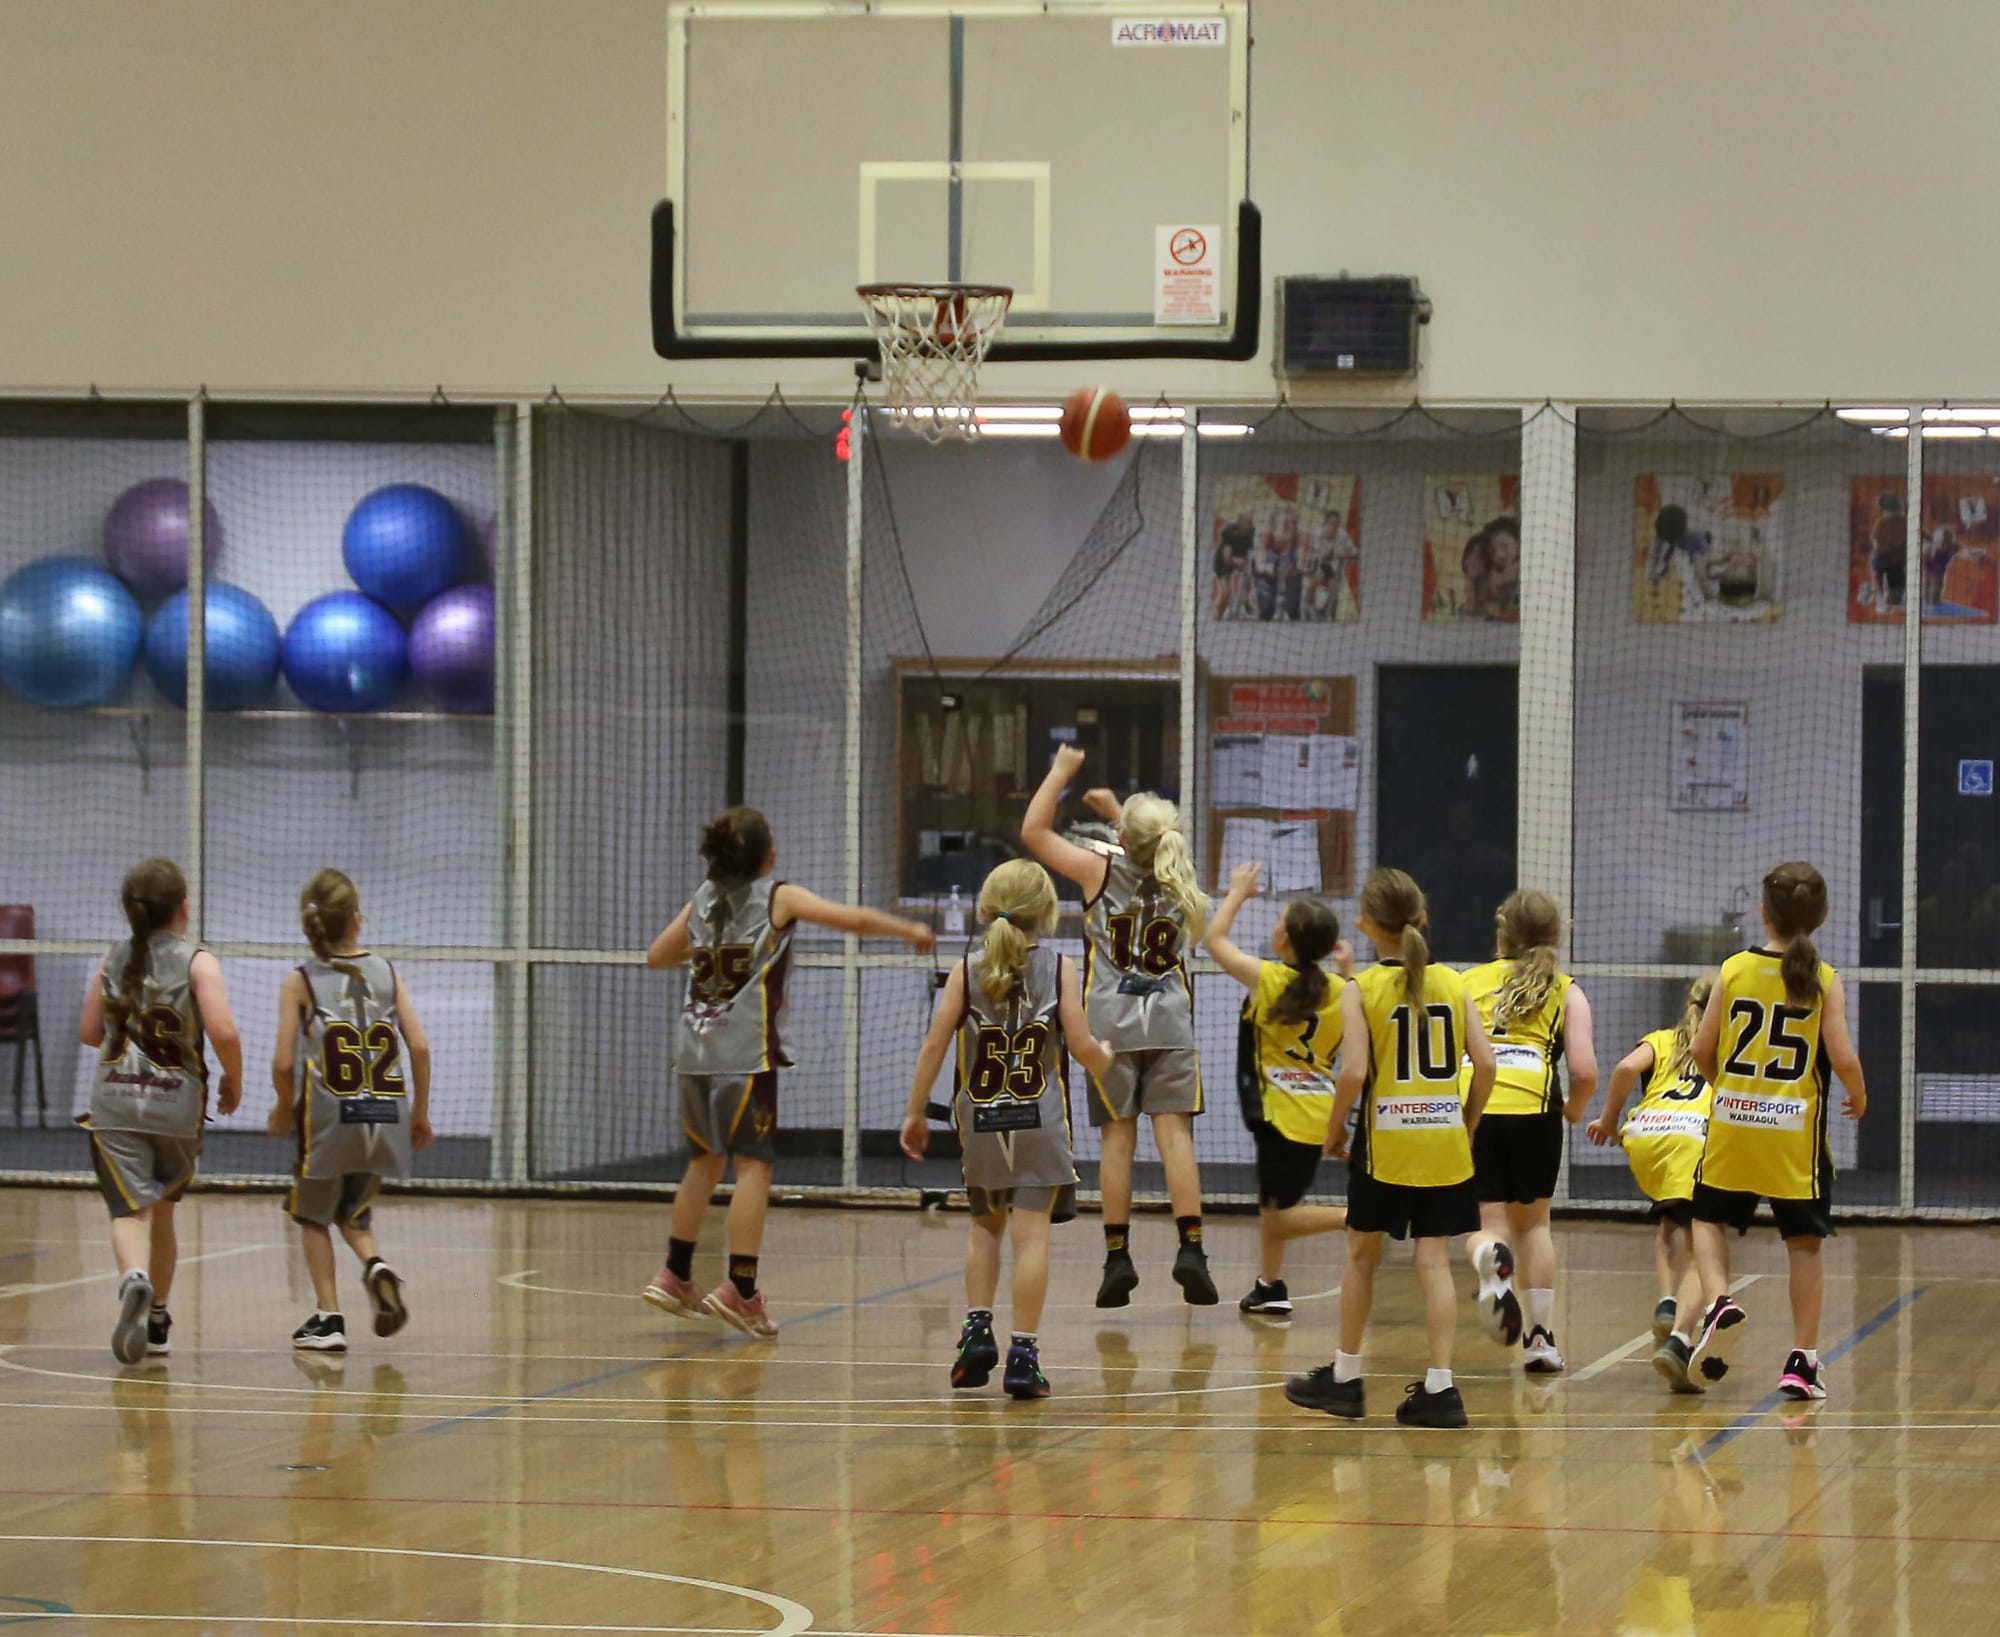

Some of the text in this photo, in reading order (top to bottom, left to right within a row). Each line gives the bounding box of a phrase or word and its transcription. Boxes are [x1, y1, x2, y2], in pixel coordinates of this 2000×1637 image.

[1117, 23, 1222, 41] ACROMAT
[689, 946, 753, 1003] 25
[1107, 914, 1181, 977] 18
[322, 1021, 406, 1096] 62
[966, 1021, 1048, 1103] 63
[1387, 1003, 1458, 1083] 10
[1723, 997, 1818, 1083] 25
[1723, 1097, 1801, 1115] INTERSPORT
[1729, 1112, 1779, 1126] WARRAGUL
